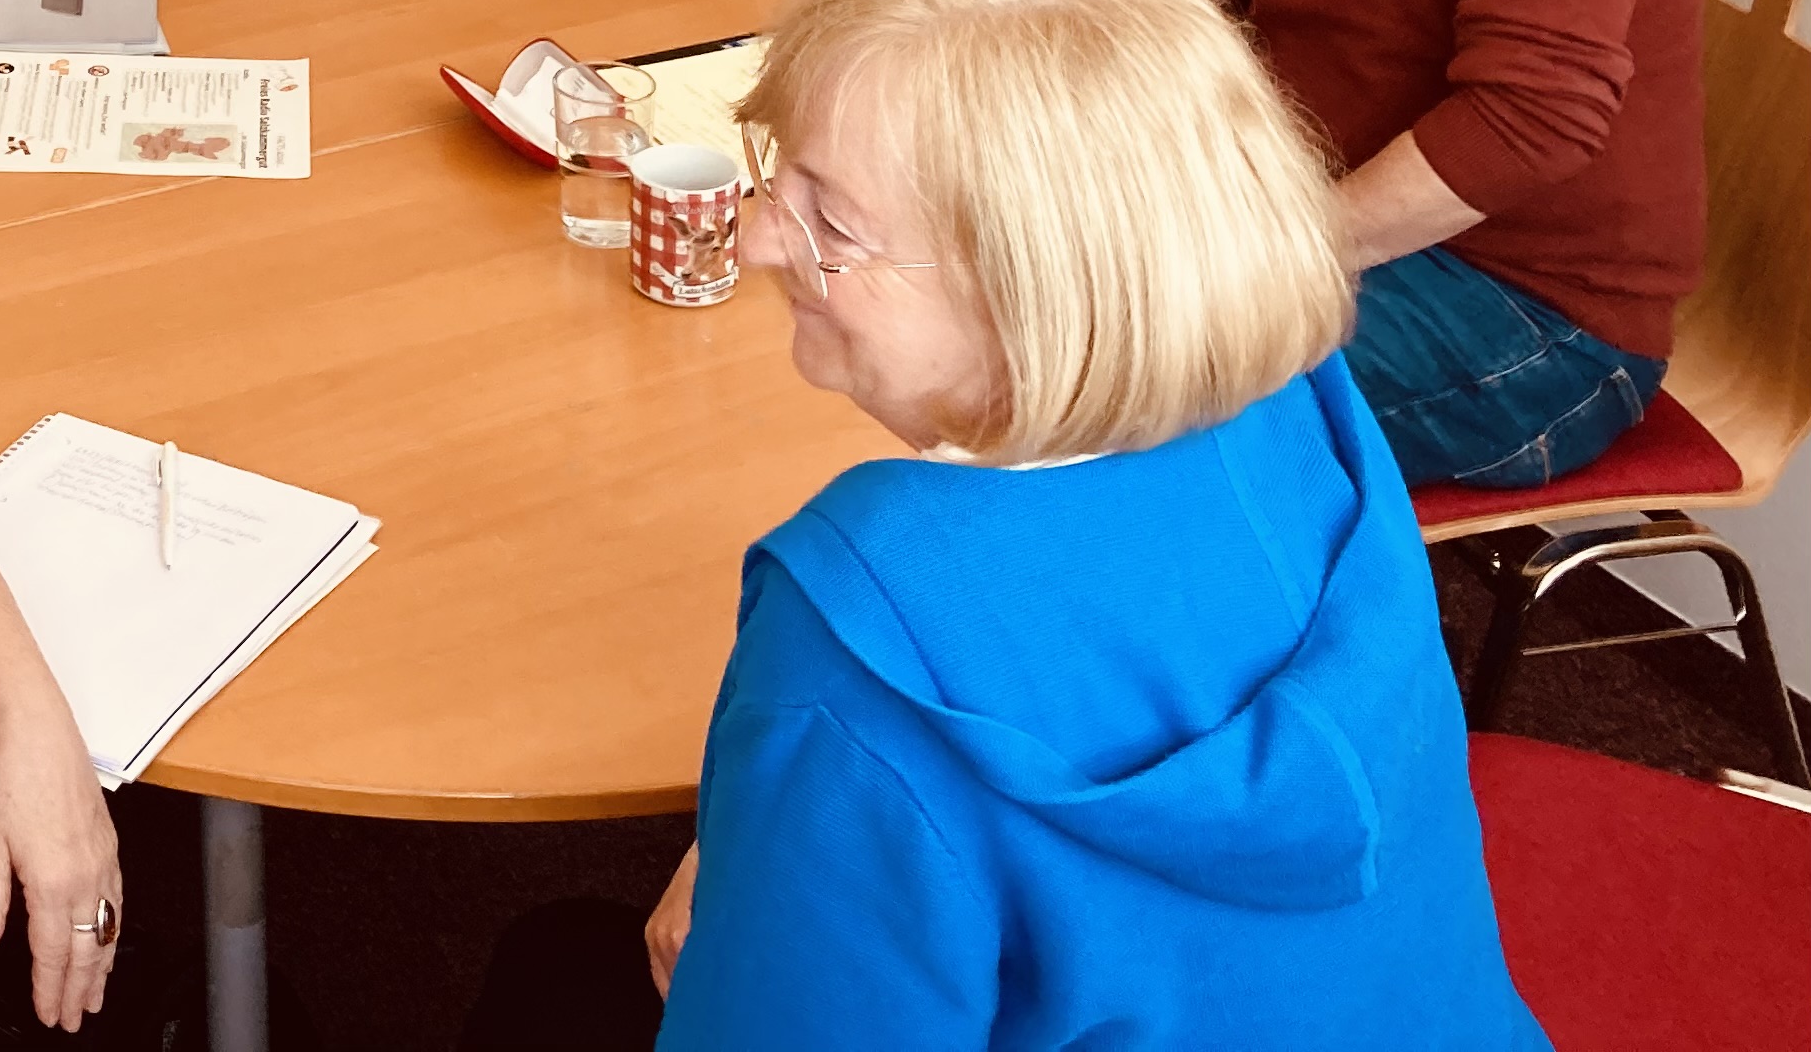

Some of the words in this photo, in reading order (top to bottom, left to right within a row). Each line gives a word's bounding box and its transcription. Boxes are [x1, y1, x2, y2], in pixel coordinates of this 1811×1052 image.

[259, 79, 270, 97] Freies
[259, 98, 271, 115] Radio
[256, 116, 271, 168] Salzkammergut
